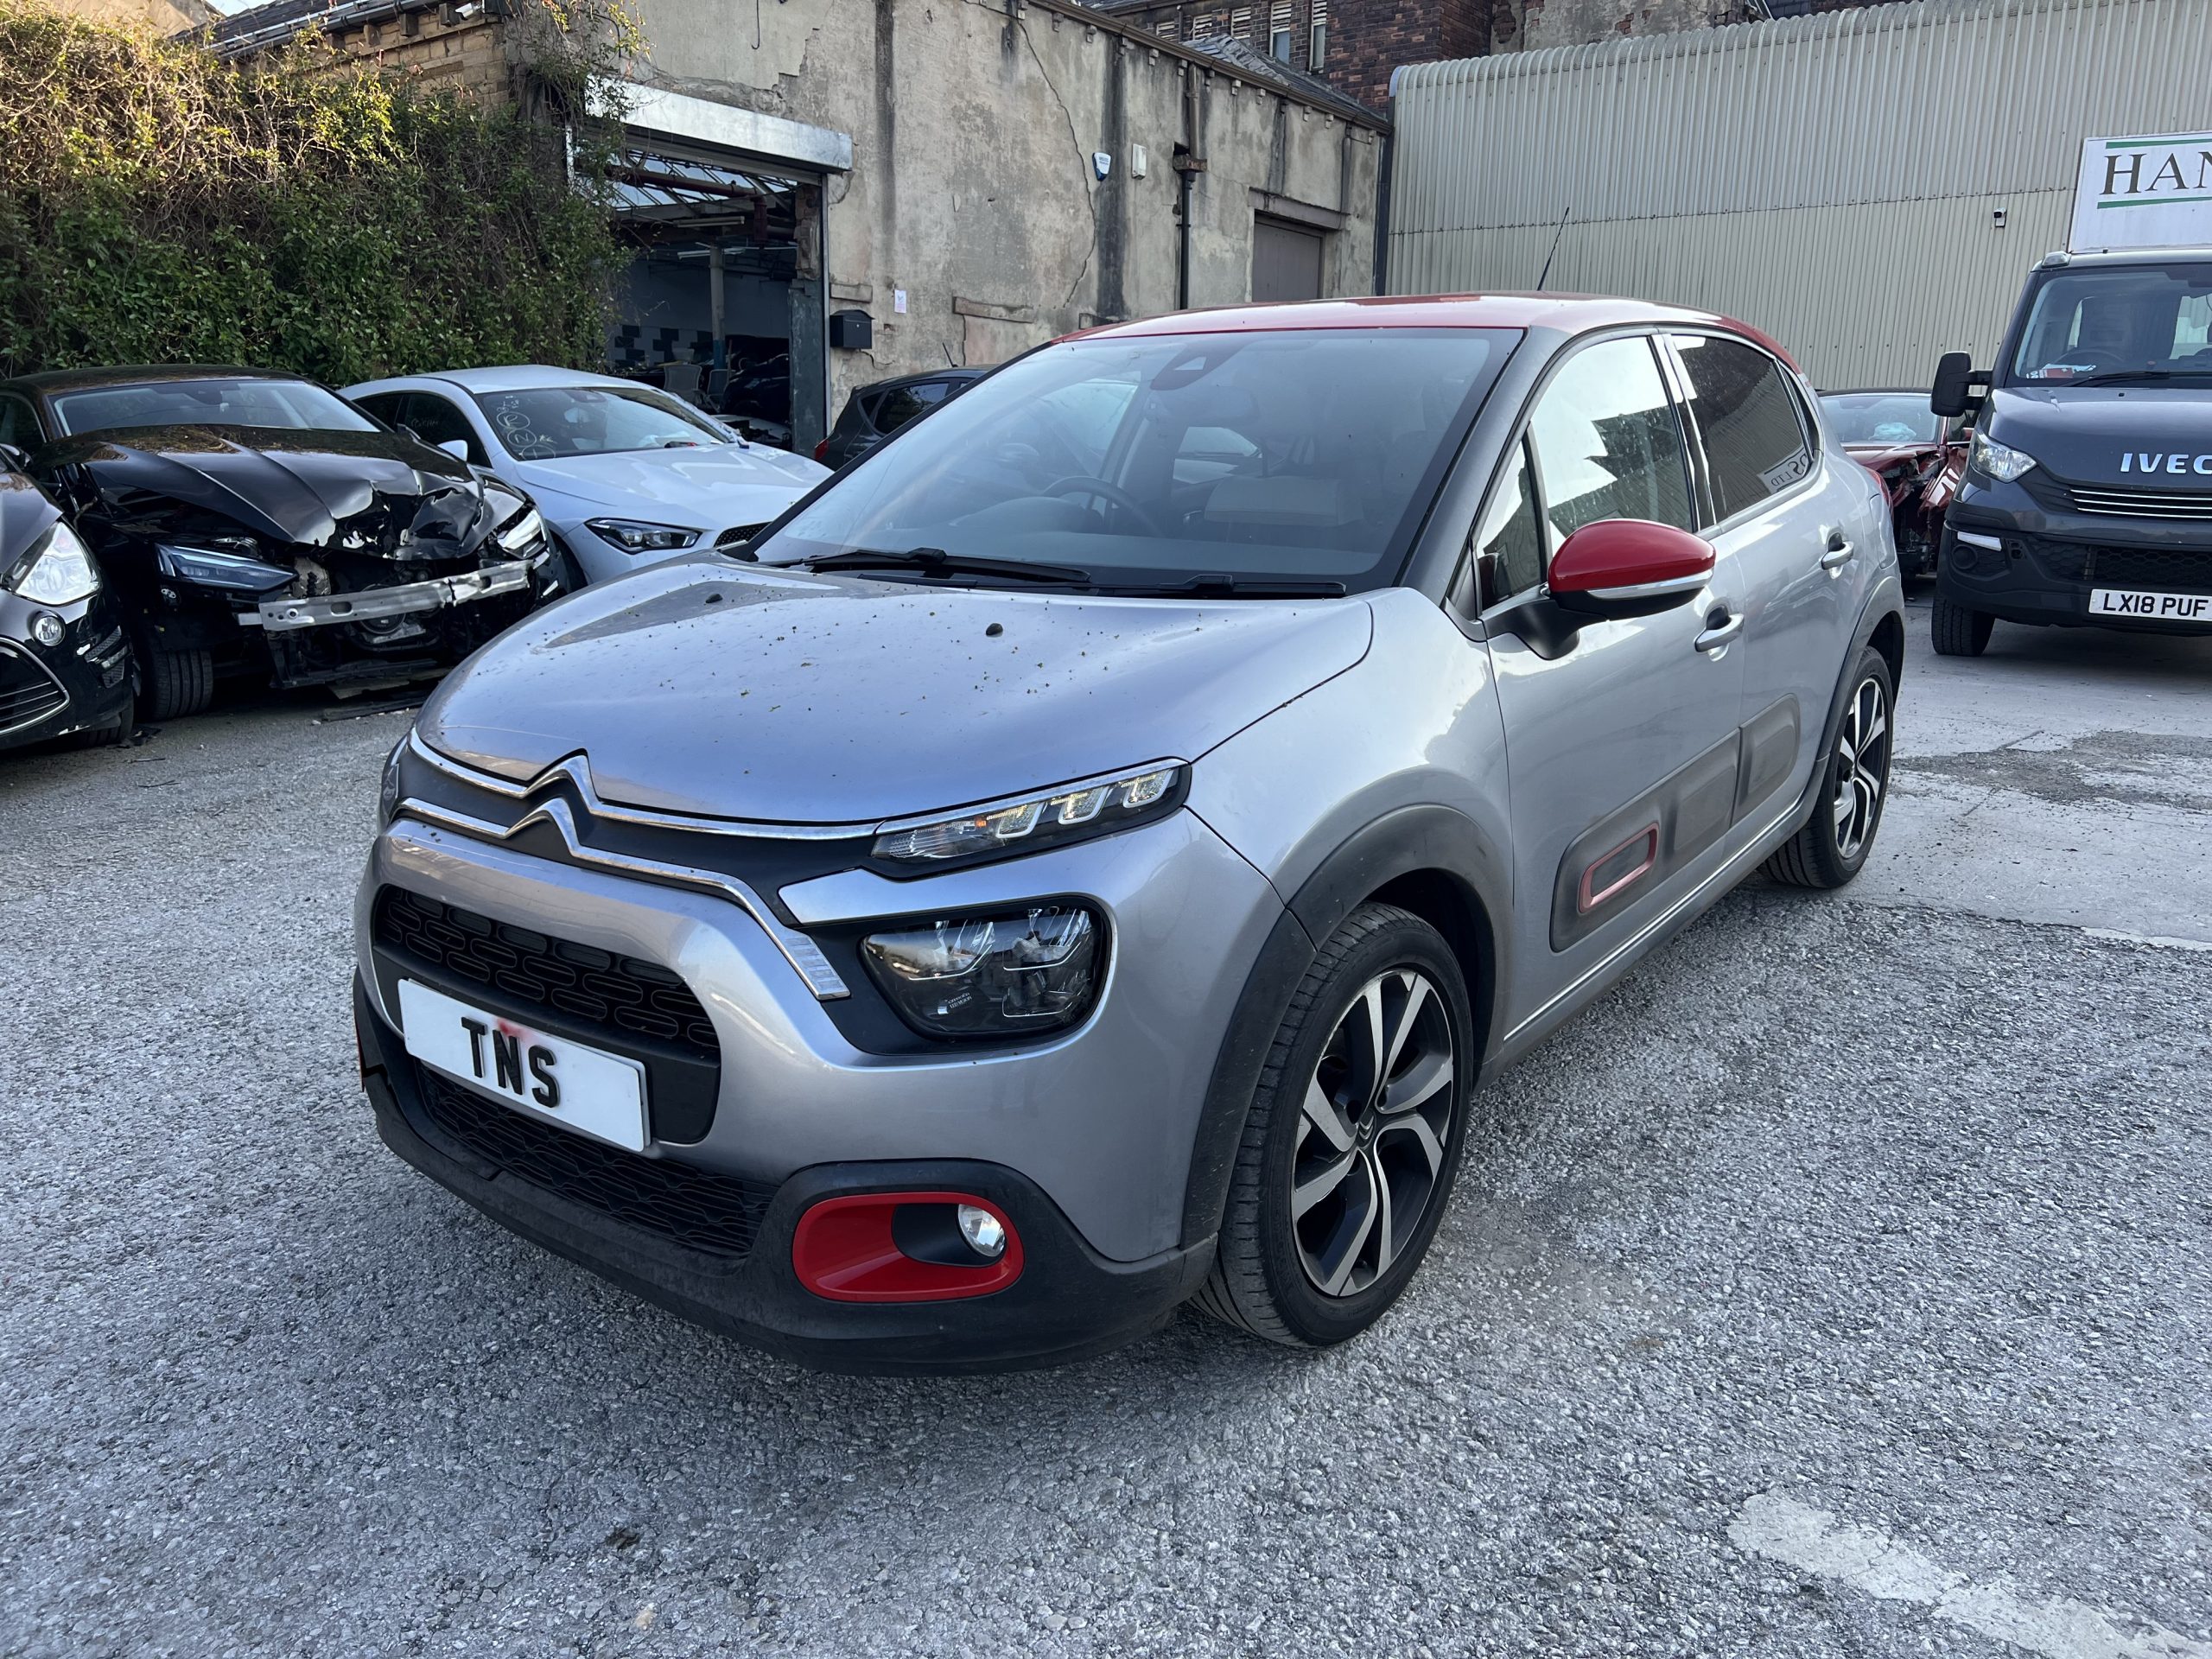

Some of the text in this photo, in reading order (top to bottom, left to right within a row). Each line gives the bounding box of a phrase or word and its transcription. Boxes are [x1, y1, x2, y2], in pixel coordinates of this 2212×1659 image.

[2102, 593, 2209, 617] LX18 PUF
[461, 1016, 560, 1108] TNS
